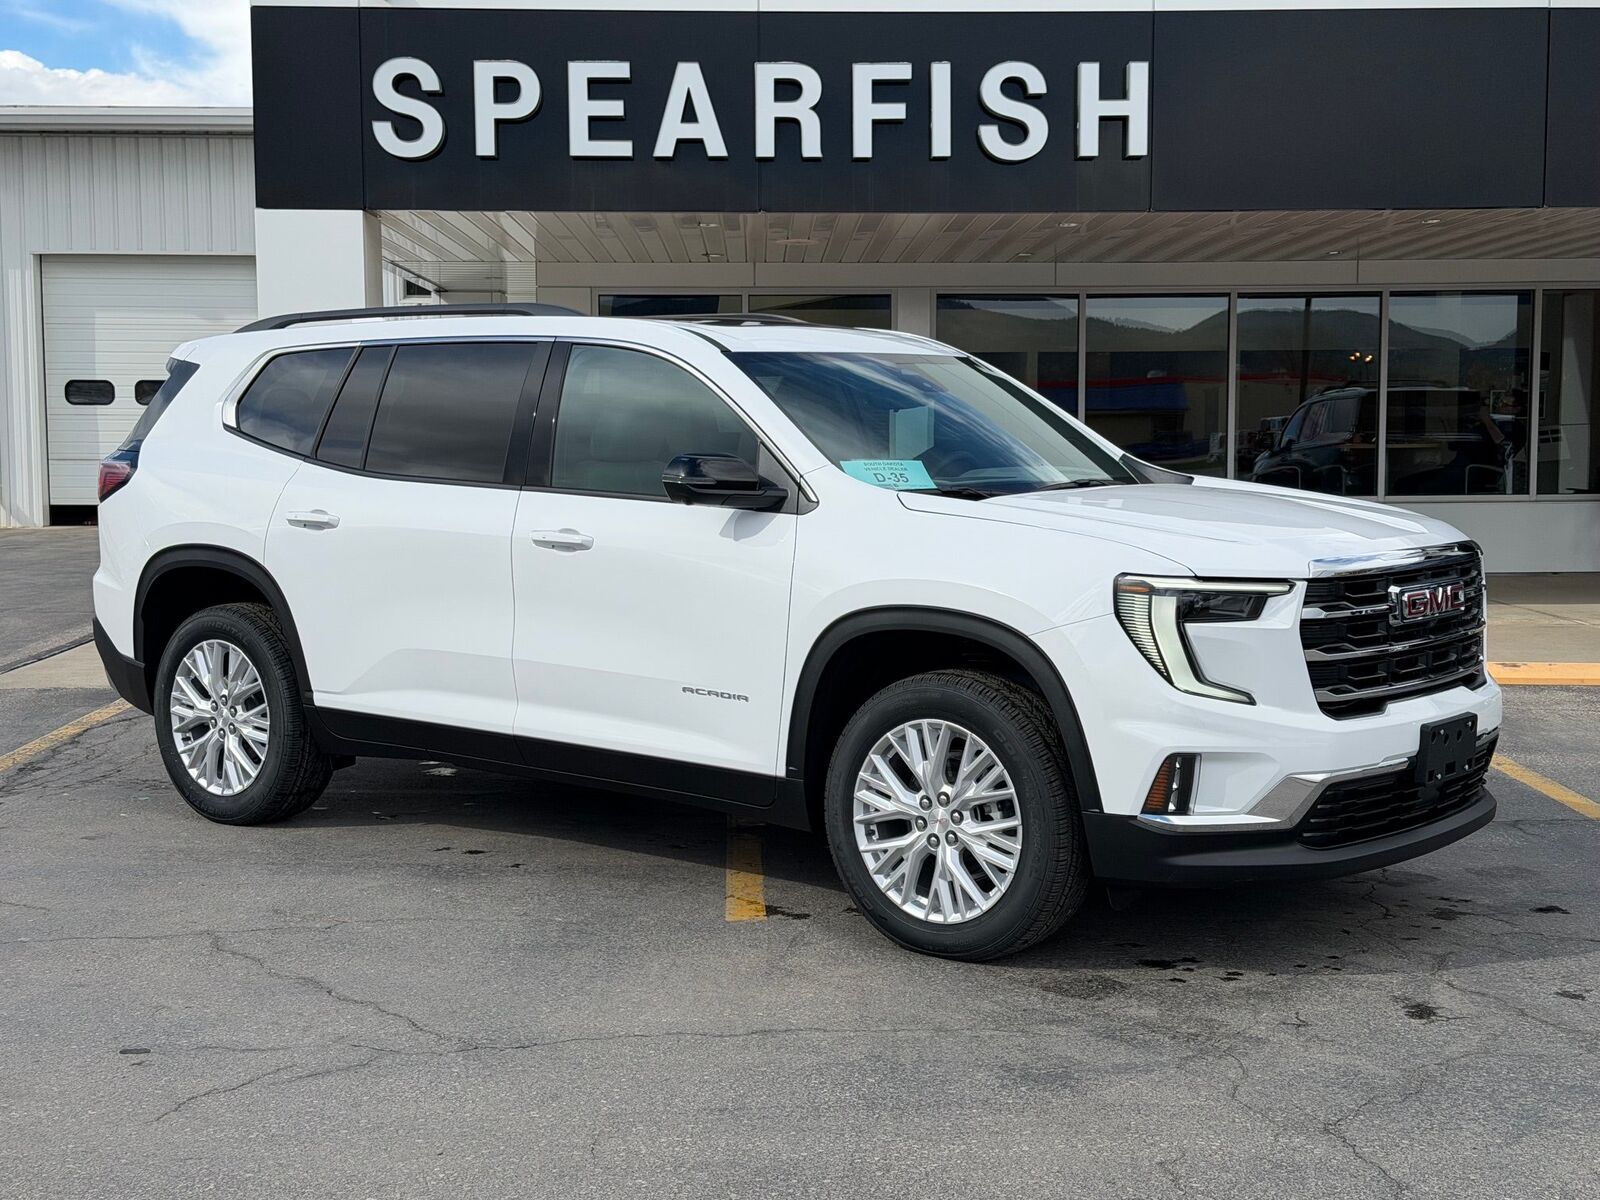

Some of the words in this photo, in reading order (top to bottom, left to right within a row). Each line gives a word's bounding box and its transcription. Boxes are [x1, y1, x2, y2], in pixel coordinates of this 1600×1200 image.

[371, 56, 1150, 162] SPEARFISH
[873, 472, 909, 483] D-35
[1402, 584, 1466, 618] GMC
[682, 686, 749, 702] ACADIA
